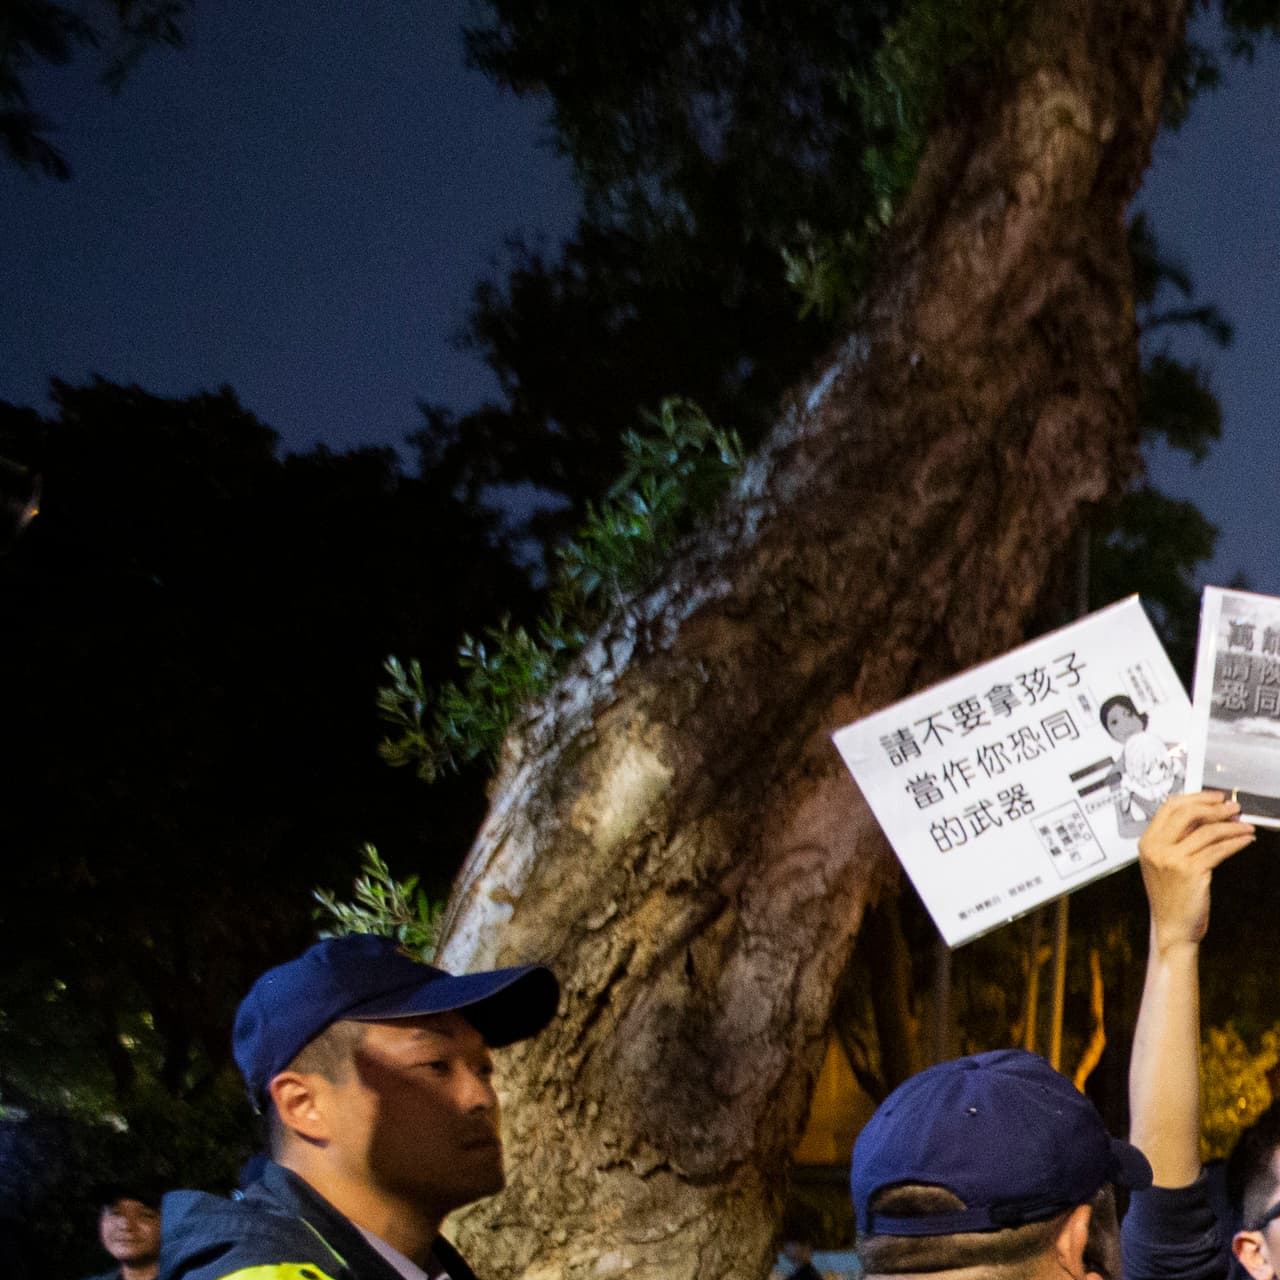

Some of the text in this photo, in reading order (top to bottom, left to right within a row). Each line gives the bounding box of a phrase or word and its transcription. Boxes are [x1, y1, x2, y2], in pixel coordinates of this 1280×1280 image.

[879, 651, 1087, 768] 請不要拿孩子
[904, 709, 1082, 811] 當作你恐同
[929, 783, 1038, 854] 的武器
